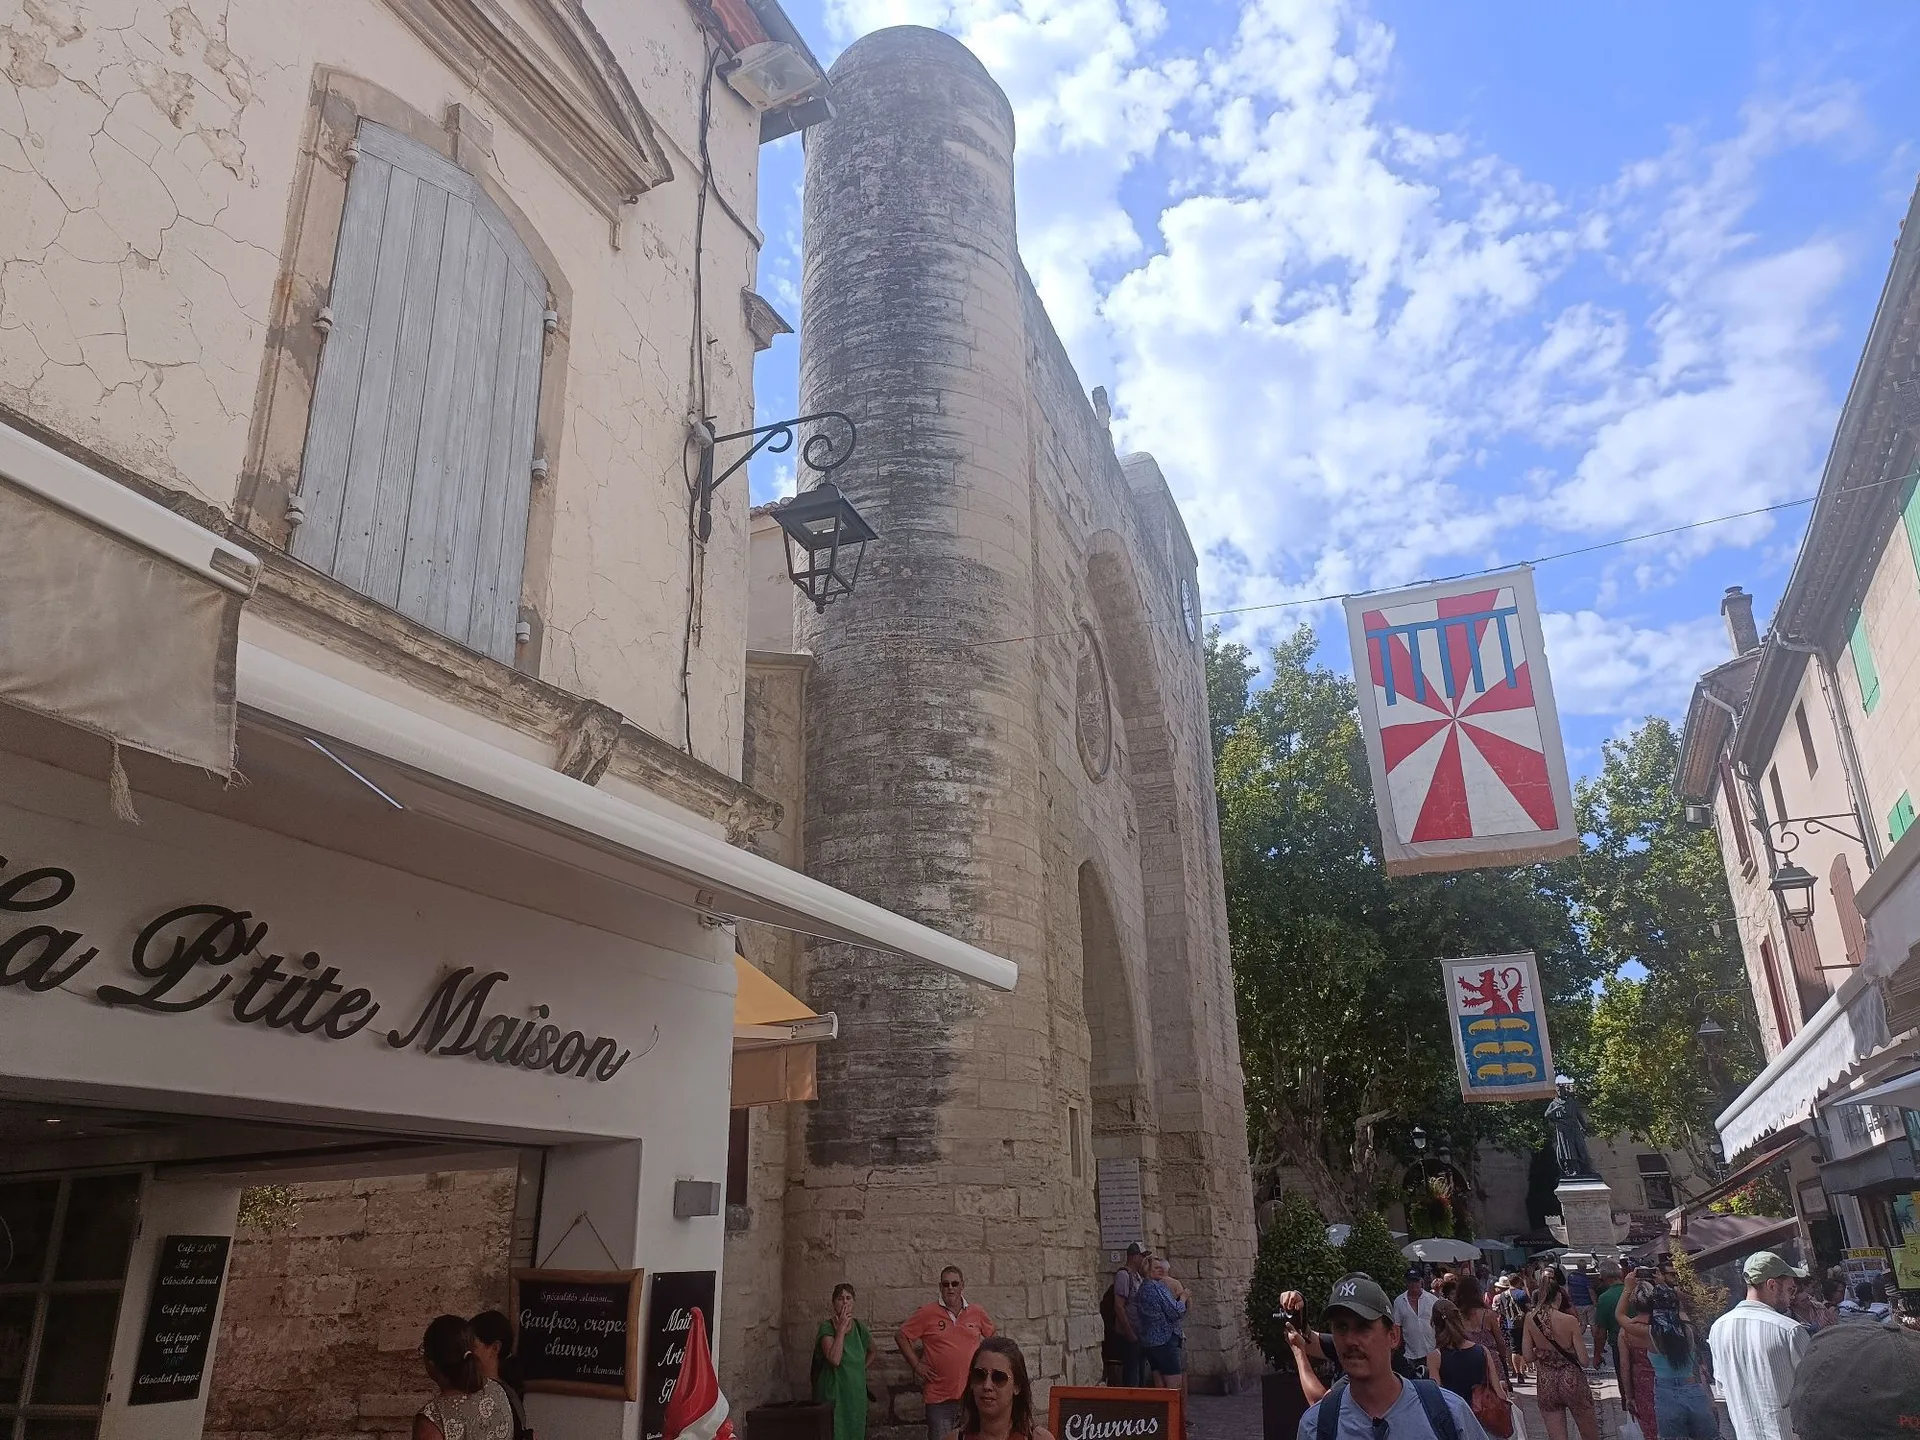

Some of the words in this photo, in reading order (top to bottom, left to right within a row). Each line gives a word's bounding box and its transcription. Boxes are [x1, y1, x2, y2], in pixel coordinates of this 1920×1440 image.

[97, 904, 380, 1041] P'tite
[387, 966, 630, 1082] Maison
[177, 1243, 196, 1255] Café
[162, 1276, 195, 1286] Chocolat
[195, 1275, 219, 1285] chaud
[1340, 1282, 1357, 1297] NY
[162, 1304, 180, 1316] Café
[180, 1303, 208, 1316] frappé
[661, 1307, 693, 1332] Maît
[938, 1320, 946, 1331] 9
[155, 1333, 174, 1345] Café
[174, 1331, 202, 1344] frappé
[174, 1344, 189, 1355] lait
[544, 1337, 599, 1358] churros
[139, 1373, 172, 1385] Chocolat
[173, 1371, 200, 1385] frappé
[1065, 1413, 1159, 1440] Churros
